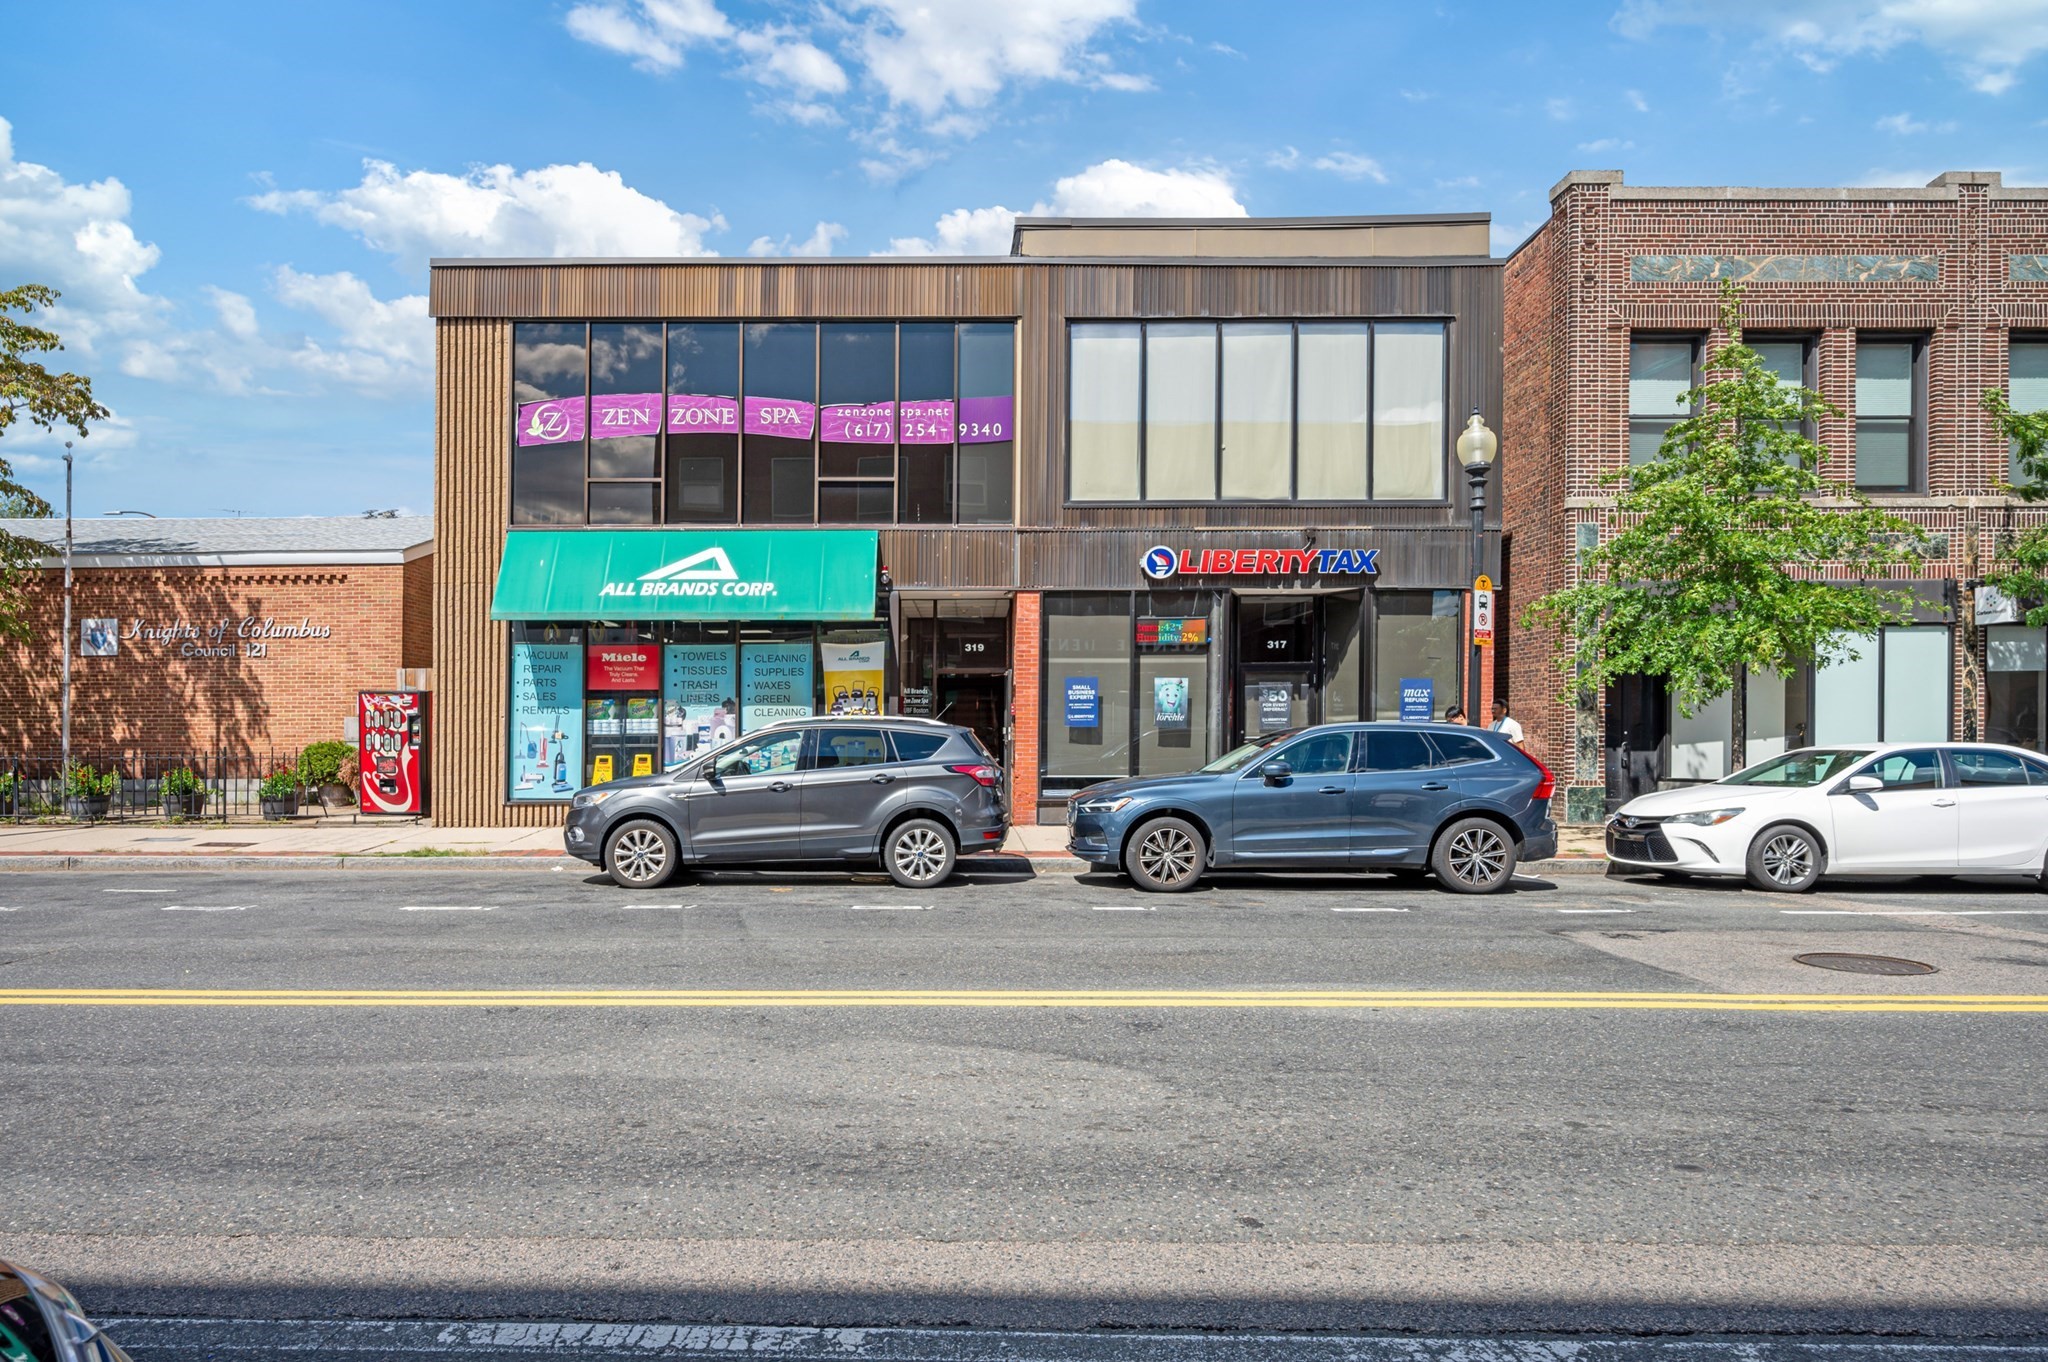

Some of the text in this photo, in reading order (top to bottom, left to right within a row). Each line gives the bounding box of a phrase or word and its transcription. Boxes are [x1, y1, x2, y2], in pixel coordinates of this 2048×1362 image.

[601, 407, 801, 425] ZEN ZONE SPA
[845, 422, 891, 439] (617)
[598, 583, 777, 596] ALL BRANDS CORP.
[120, 616, 331, 645] Knights of Columbus
[964, 643, 985, 652] 319
[1266, 640, 1287, 649] 317
[181, 643, 267, 657] Council 121
[523, 651, 568, 660] VACUUM
[601, 653, 647, 662] Miele
[681, 651, 727, 661] TOWELS
[754, 654, 807, 663] CLEANING
[523, 665, 562, 673] REPAIR
[681, 666, 728, 675] TISSUES
[754, 667, 805, 677] SUPPLIES
[523, 678, 557, 687] PARTS
[681, 680, 718, 689] TRASH
[754, 681, 791, 690] WAXES
[522, 692, 557, 701] SALES
[1262, 689, 1288, 702] $50
[1403, 688, 1430, 697] max
[680, 693, 720, 703] LINERS
[754, 694, 791, 703] GREEN
[522, 706, 570, 715] RENTALS
[754, 708, 807, 717] CLEANING
